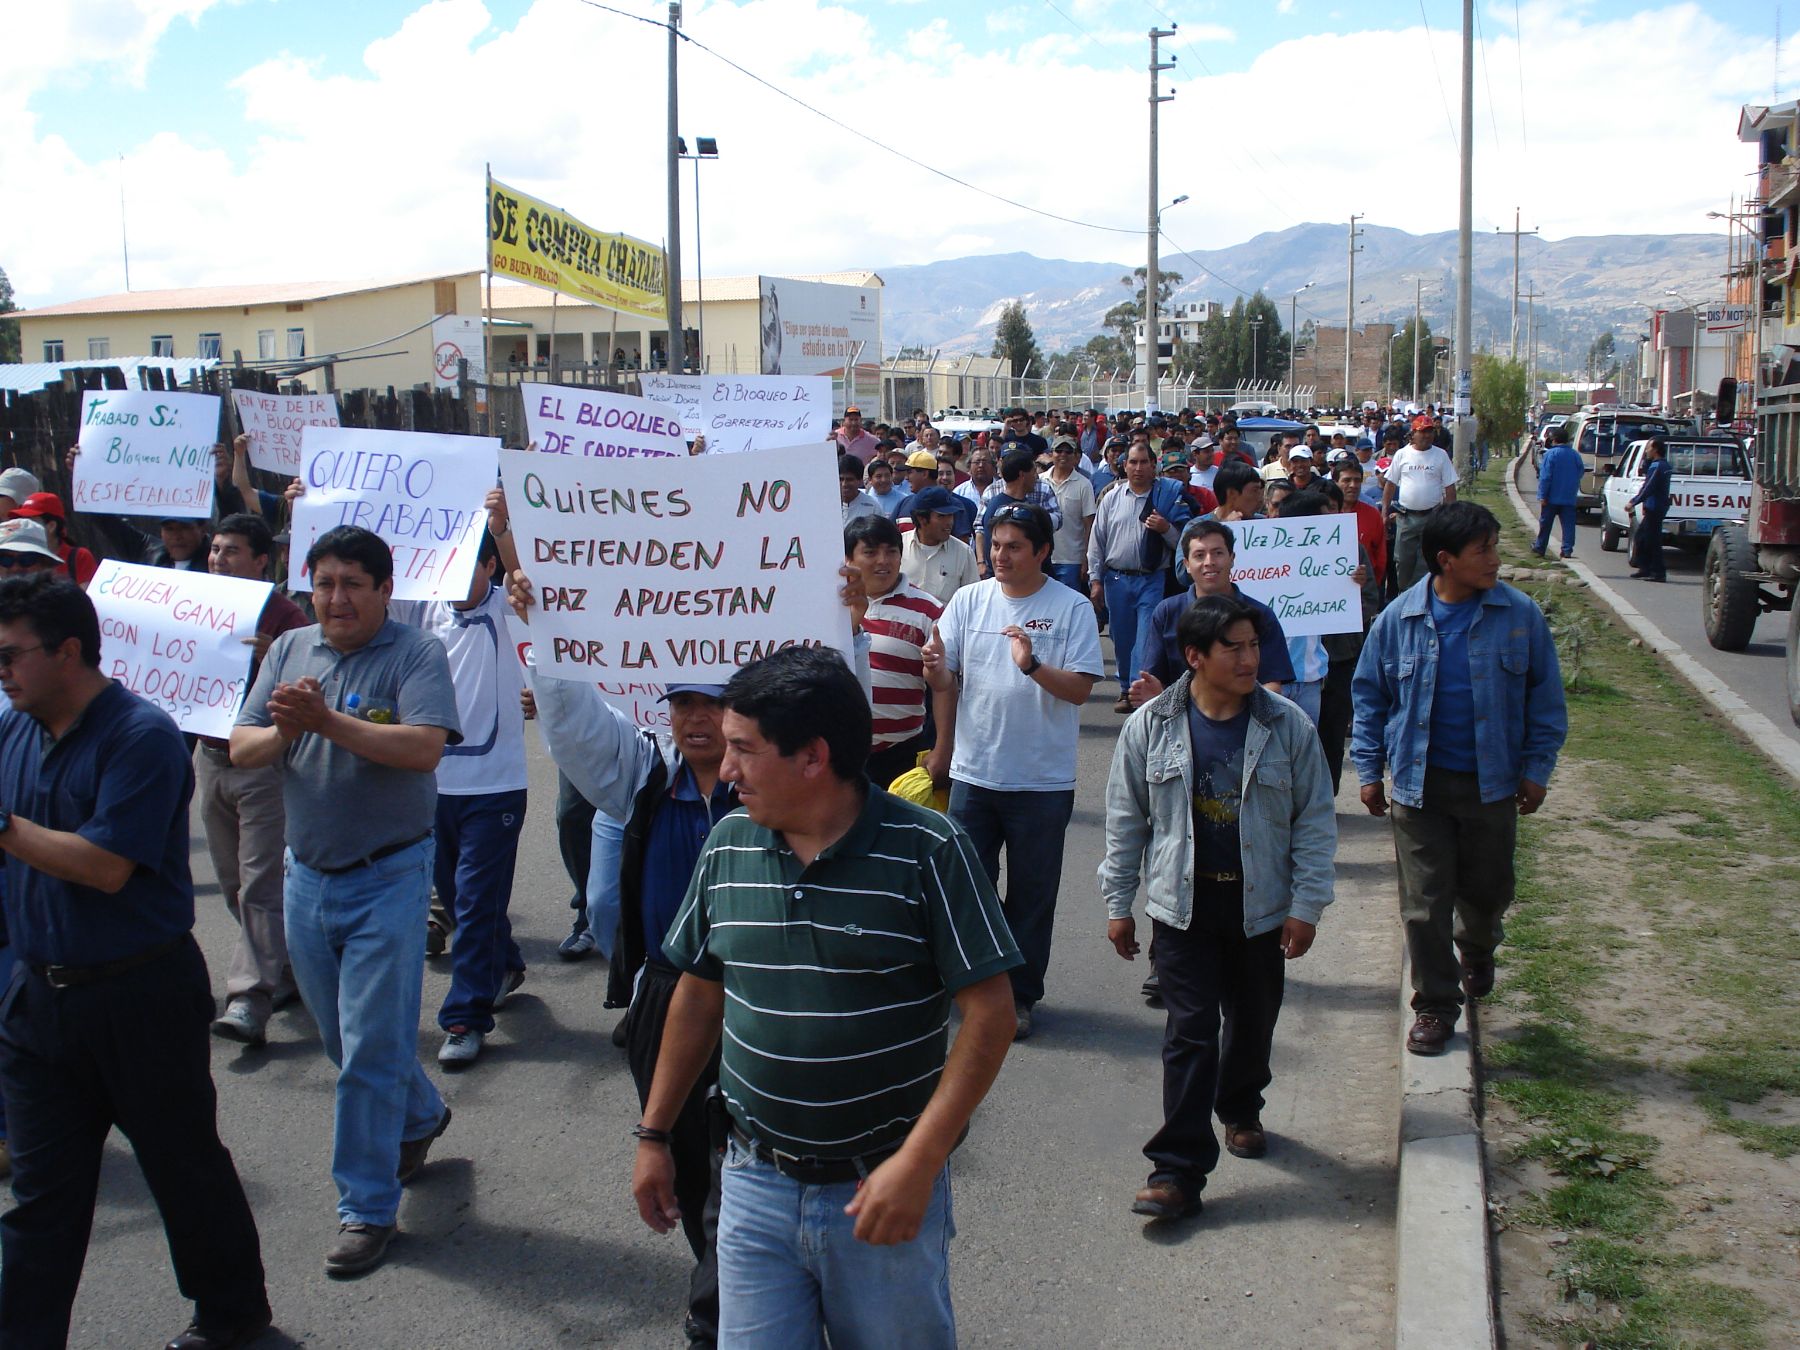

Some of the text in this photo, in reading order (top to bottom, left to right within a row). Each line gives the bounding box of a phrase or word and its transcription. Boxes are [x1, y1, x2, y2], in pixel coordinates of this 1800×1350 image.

[492, 191, 519, 246] SE
[526, 207, 601, 277] COMPRA
[509, 260, 532, 275] BUEN
[533, 265, 559, 285] PRECIO
[1707, 310, 1721, 321] DIS
[85, 398, 139, 426] TRABAJO
[240, 394, 326, 413] EN VEZ DE IR
[539, 396, 681, 437] EL BLOQUEO
[272, 433, 287, 445] SE
[540, 431, 681, 457] DE CARRE
[308, 450, 434, 498] QUIERO
[736, 479, 791, 518] NO
[1669, 493, 1752, 508] NISSAN
[333, 500, 484, 546] TRABAJAR
[1326, 524, 1341, 545] A
[533, 535, 806, 571] DEFIENDEN LA
[100, 567, 236, 636] ¿QUIEN GANA
[541, 584, 777, 618] PAZ APUESTAN
[1278, 592, 1347, 619] TRABAJAR
[102, 618, 197, 663] CON LOS
[553, 637, 608, 668] POR
[621, 640, 658, 669] LA
[111, 659, 246, 718] BLOQUEOS?
